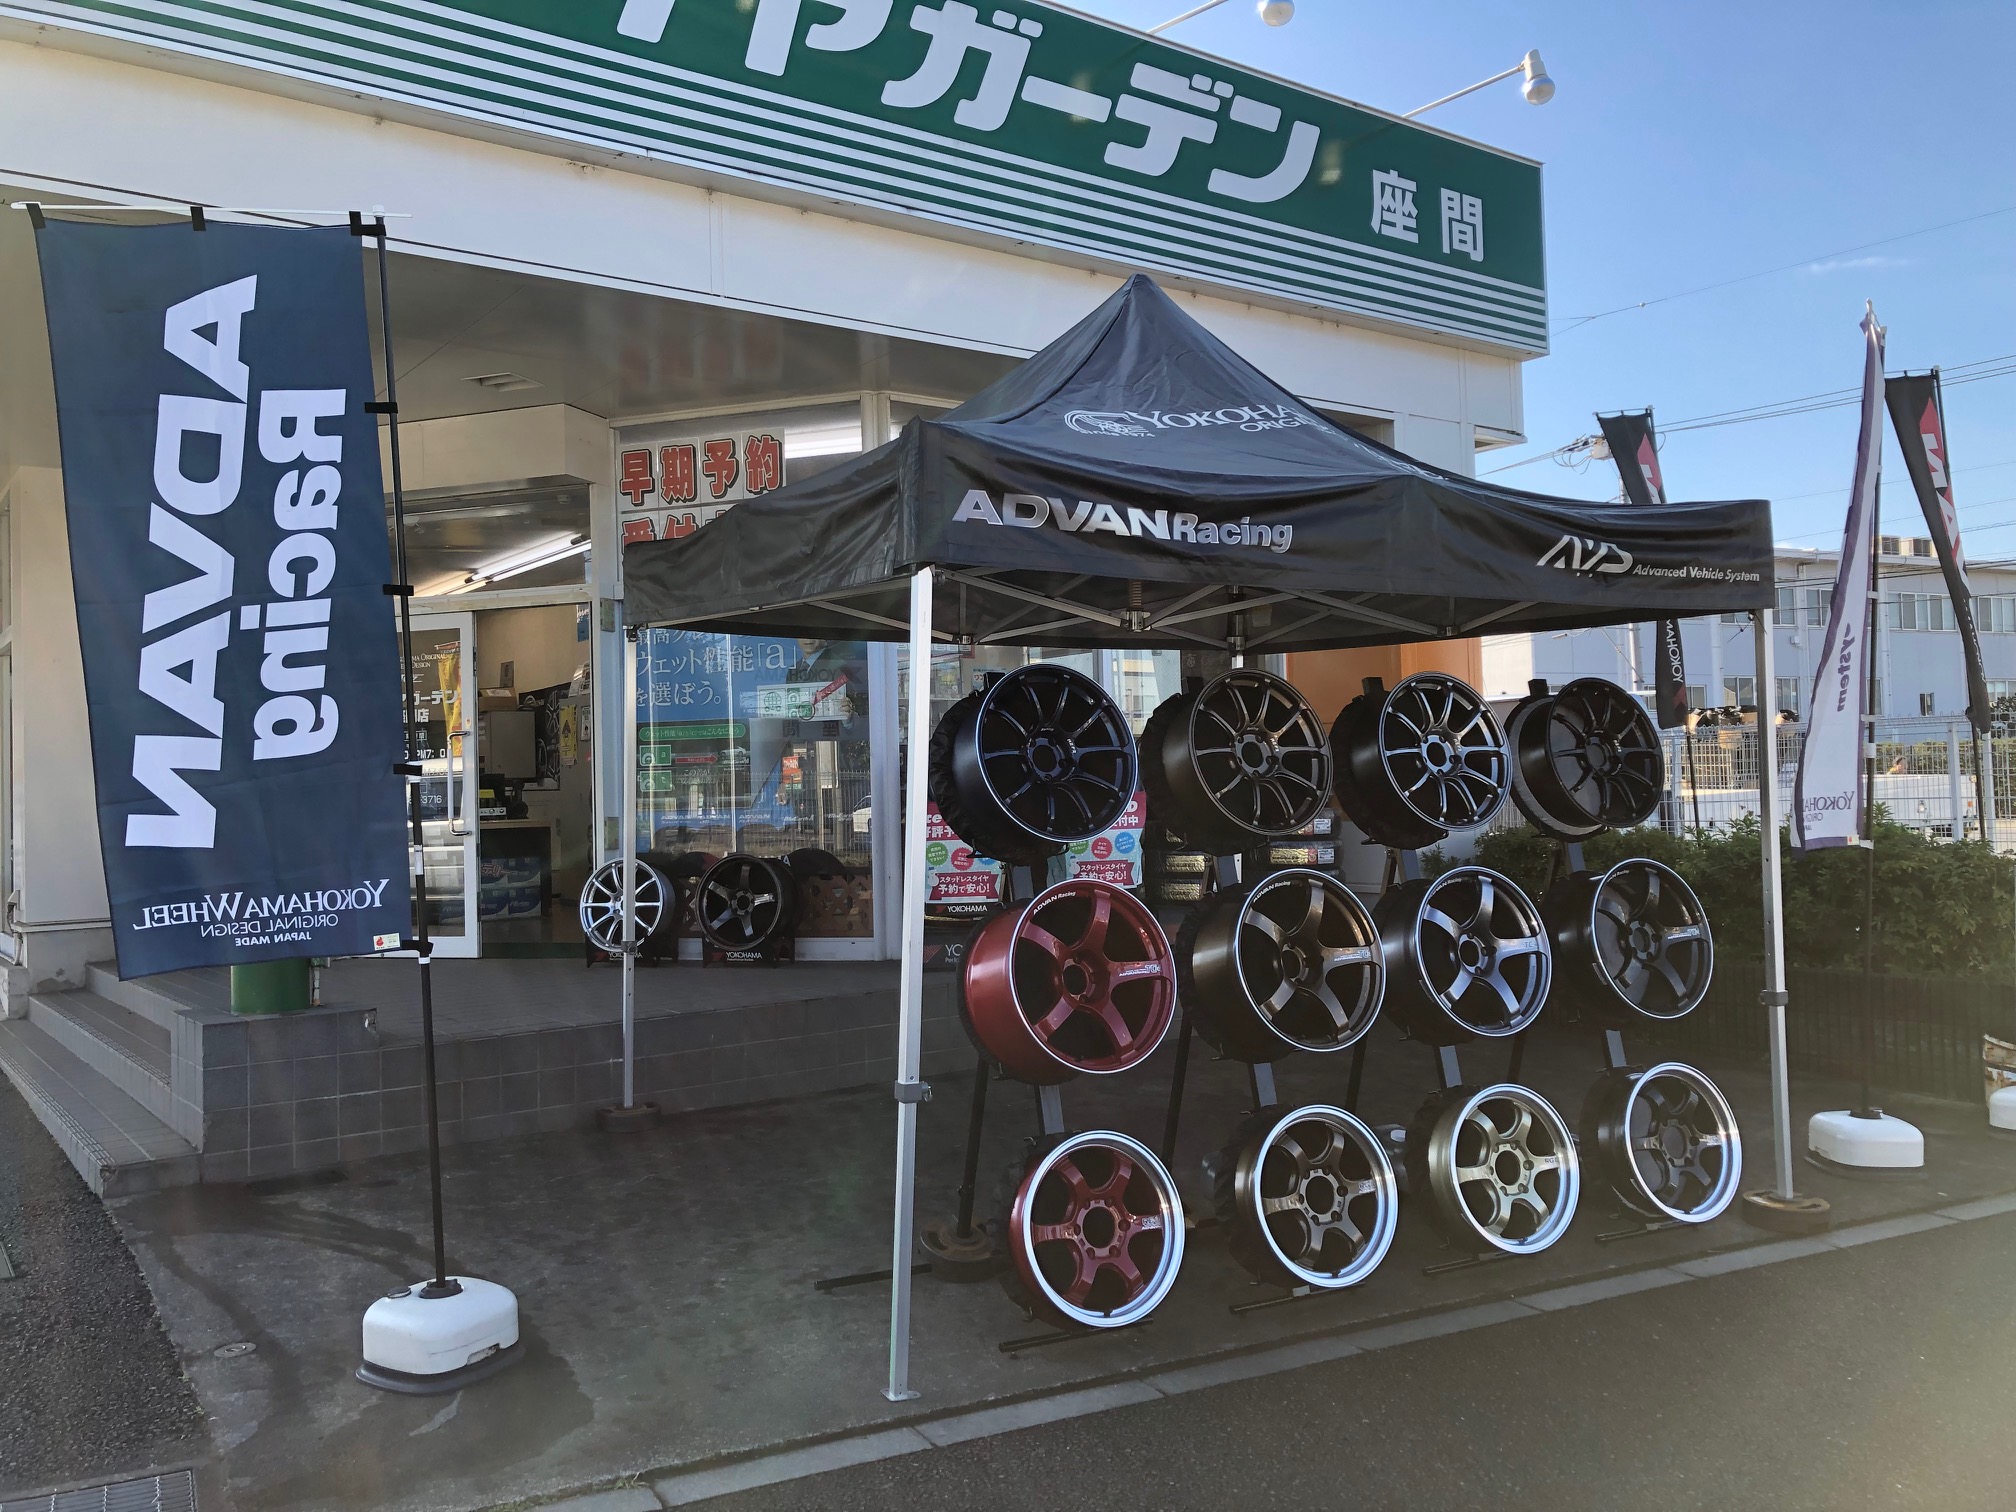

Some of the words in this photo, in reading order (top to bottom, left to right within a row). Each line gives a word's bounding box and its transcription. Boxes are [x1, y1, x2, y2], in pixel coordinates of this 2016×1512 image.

[1371, 169, 1484, 262] 座間
[1127, 404, 1304, 429] YOKOHA
[621, 435, 783, 506] 早期予約
[952, 489, 1171, 540] ADVAN
[1173, 513, 1293, 554] Racing
[1633, 564, 1687, 577] Advanced
[1689, 566, 1724, 580] Vehicle
[1725, 569, 1760, 583] System
[1081, 863, 1127, 871] スタッドレスタイヤ
[938, 884, 990, 894] 予約で安心!
[940, 875, 989, 883] スタッドレスタイヤ
[1033, 895, 1058, 915] ADVAN
